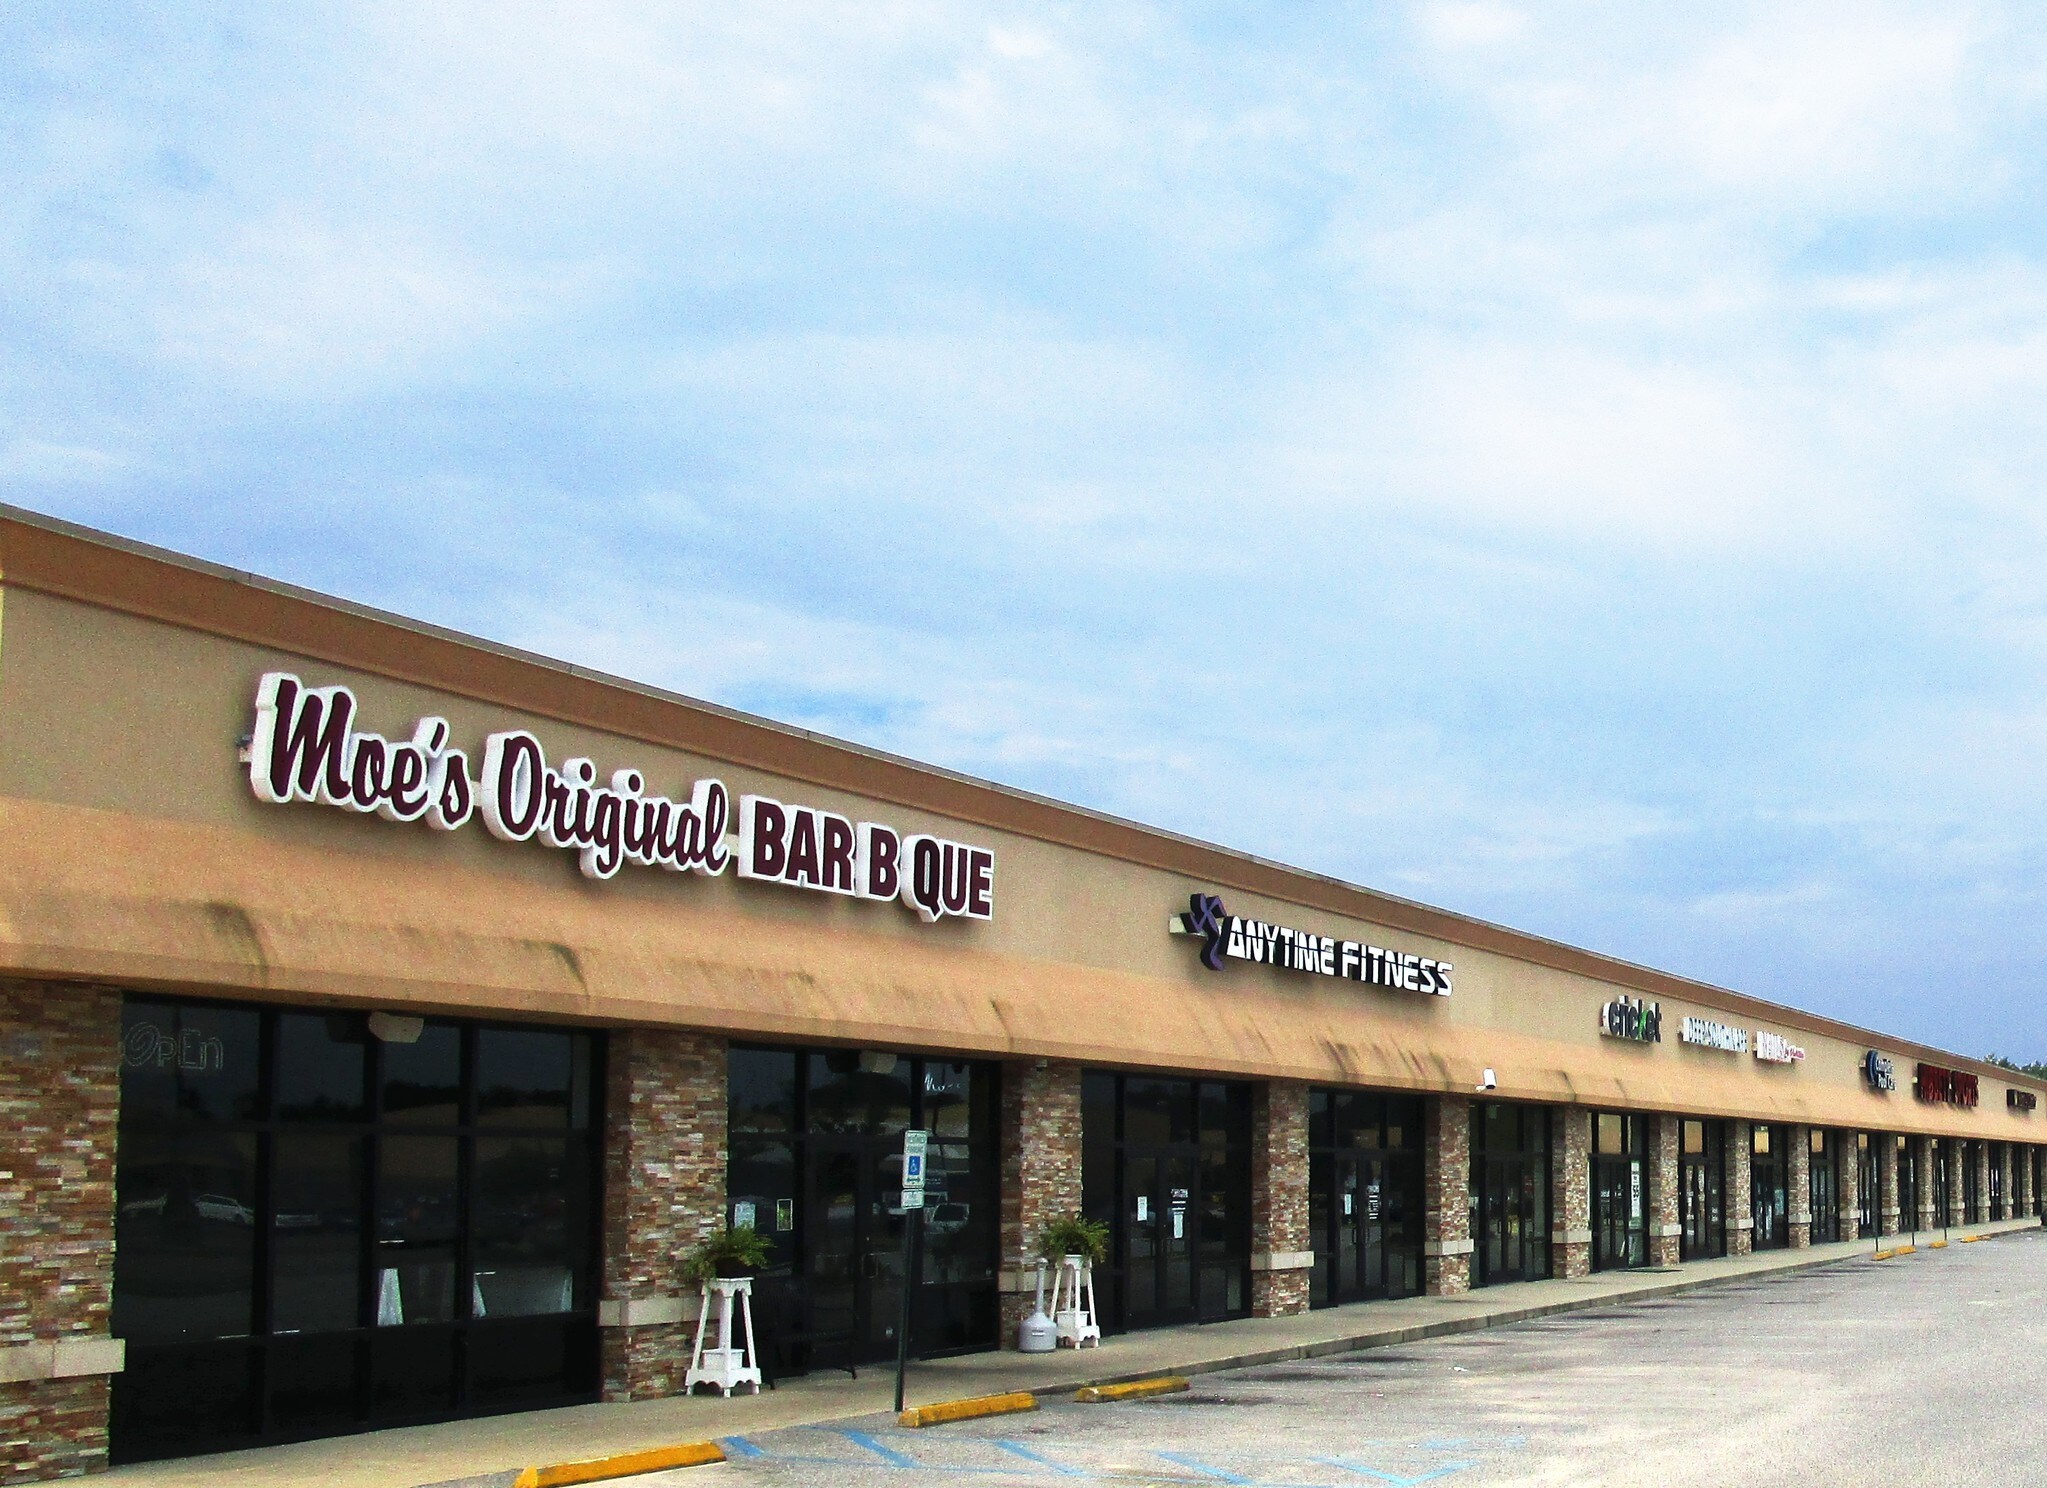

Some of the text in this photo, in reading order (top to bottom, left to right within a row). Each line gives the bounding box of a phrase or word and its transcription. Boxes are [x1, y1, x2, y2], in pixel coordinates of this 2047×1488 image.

[254, 674, 993, 921] Moe's Original BAR B QUE
[1226, 916, 1453, 997] ANYTIME FITNESS
[1605, 995, 1662, 1042] cricket
